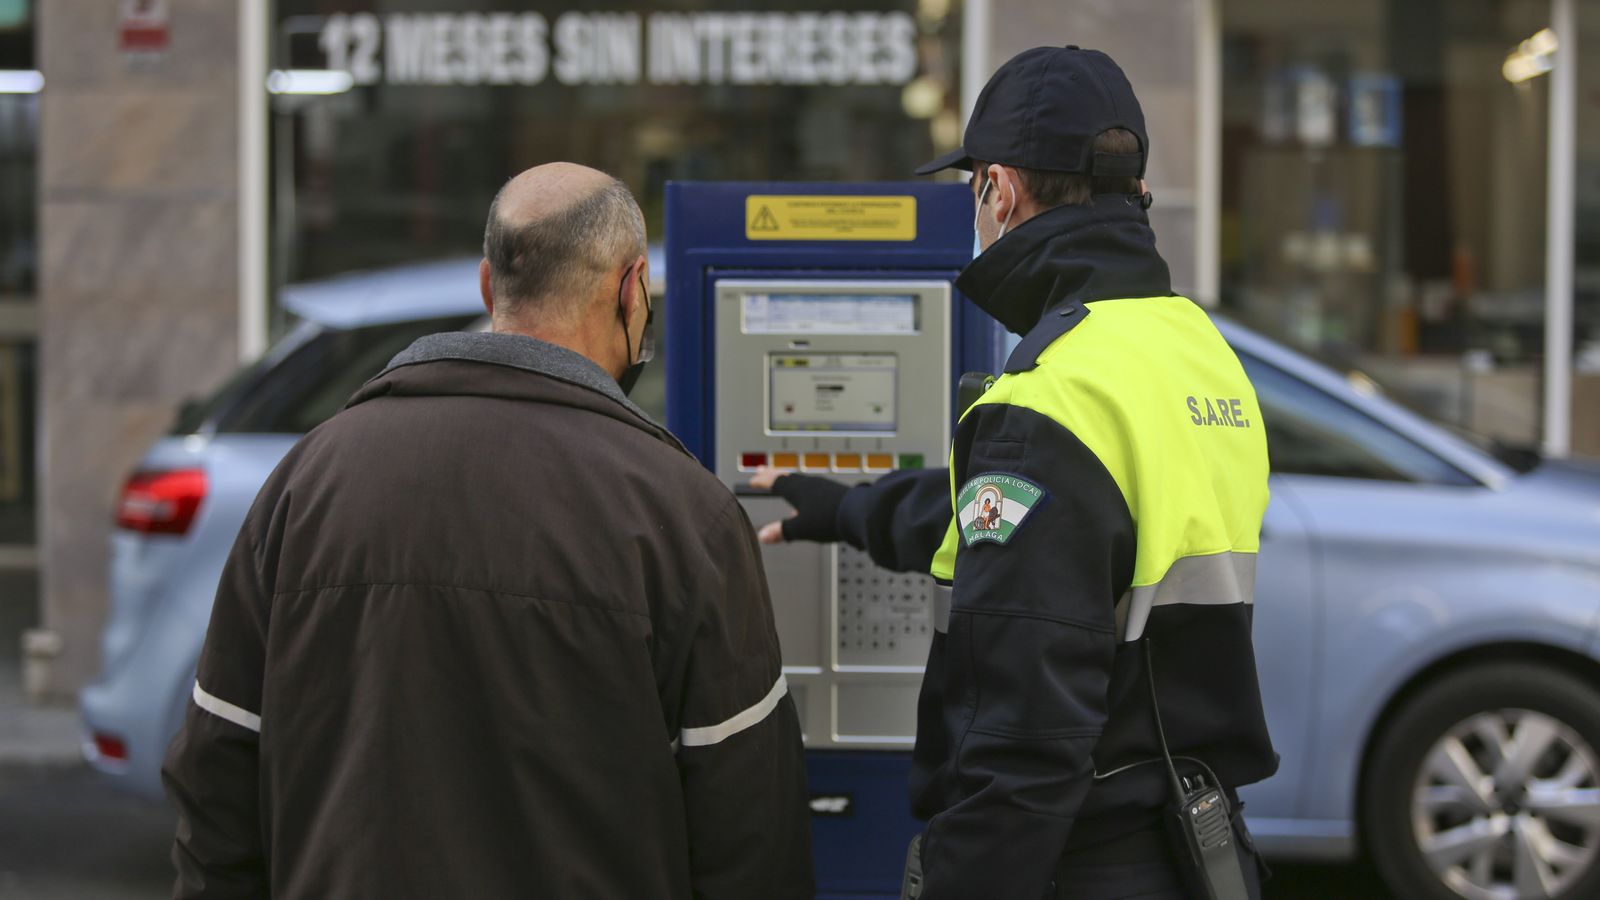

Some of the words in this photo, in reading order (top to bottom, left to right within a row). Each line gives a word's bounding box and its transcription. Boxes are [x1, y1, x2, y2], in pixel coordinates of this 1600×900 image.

[319, 11, 382, 85] 12
[385, 11, 549, 85] MESES
[553, 11, 641, 85] SIN
[647, 10, 917, 85] INTERESES
[1012, 479, 1039, 497] LOCAL
[968, 531, 1003, 543] MALAGA
